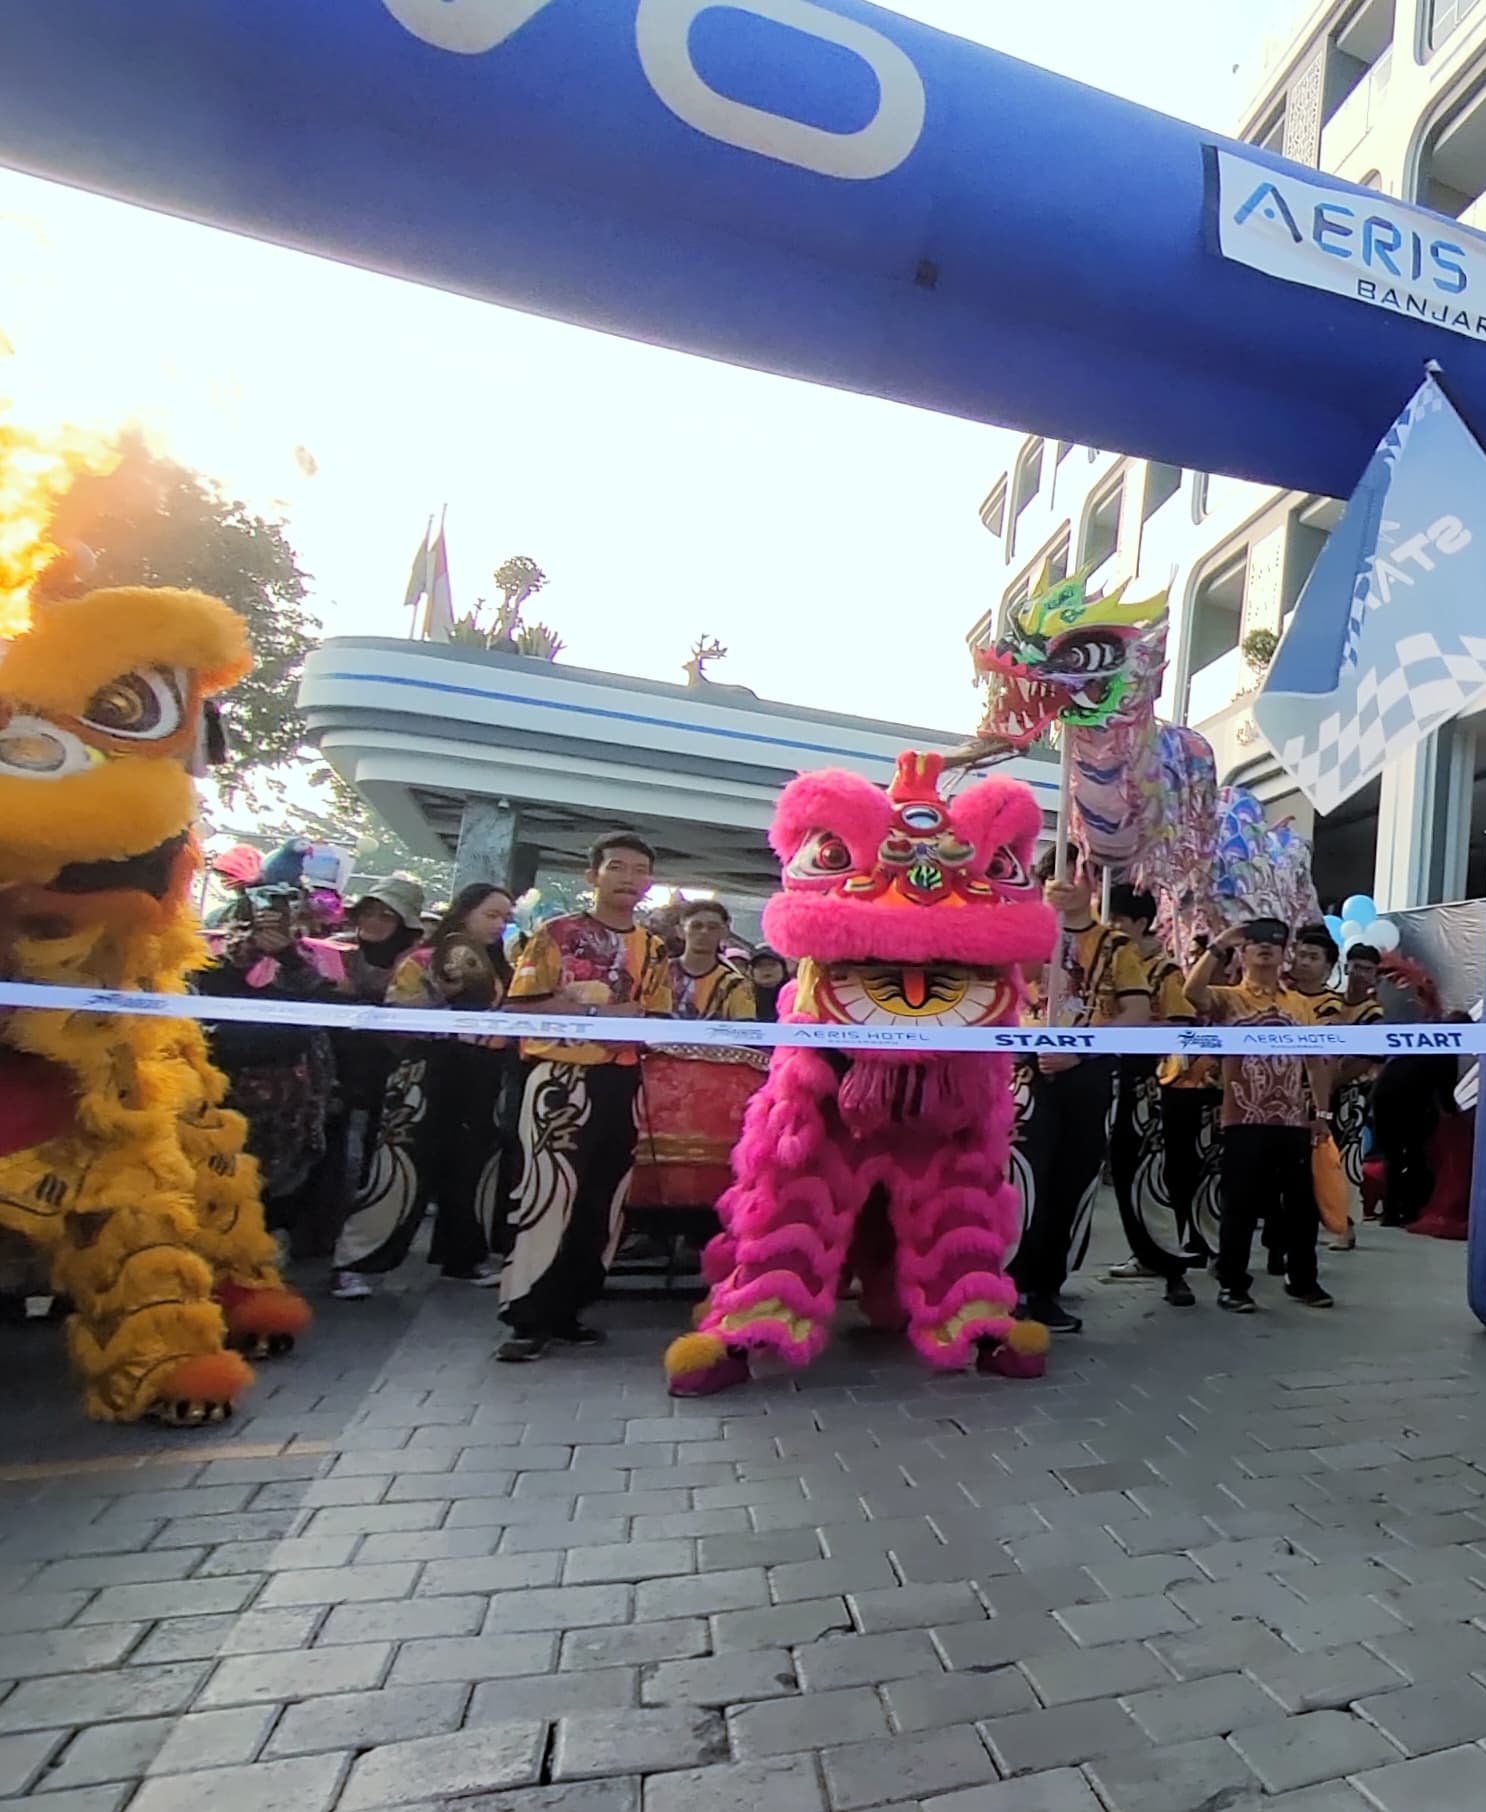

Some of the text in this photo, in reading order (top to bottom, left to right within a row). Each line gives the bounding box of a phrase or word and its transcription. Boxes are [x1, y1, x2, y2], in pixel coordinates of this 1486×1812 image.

[1233, 181, 1468, 295] AERIS
[452, 1016, 595, 1034] START
[794, 1030, 860, 1040] AERIS
[867, 1031, 930, 1042] HOTEL
[994, 1033, 1096, 1047] START
[1243, 1033, 1347, 1044] AERIS HOTEL
[1385, 1032, 1463, 1048] START
